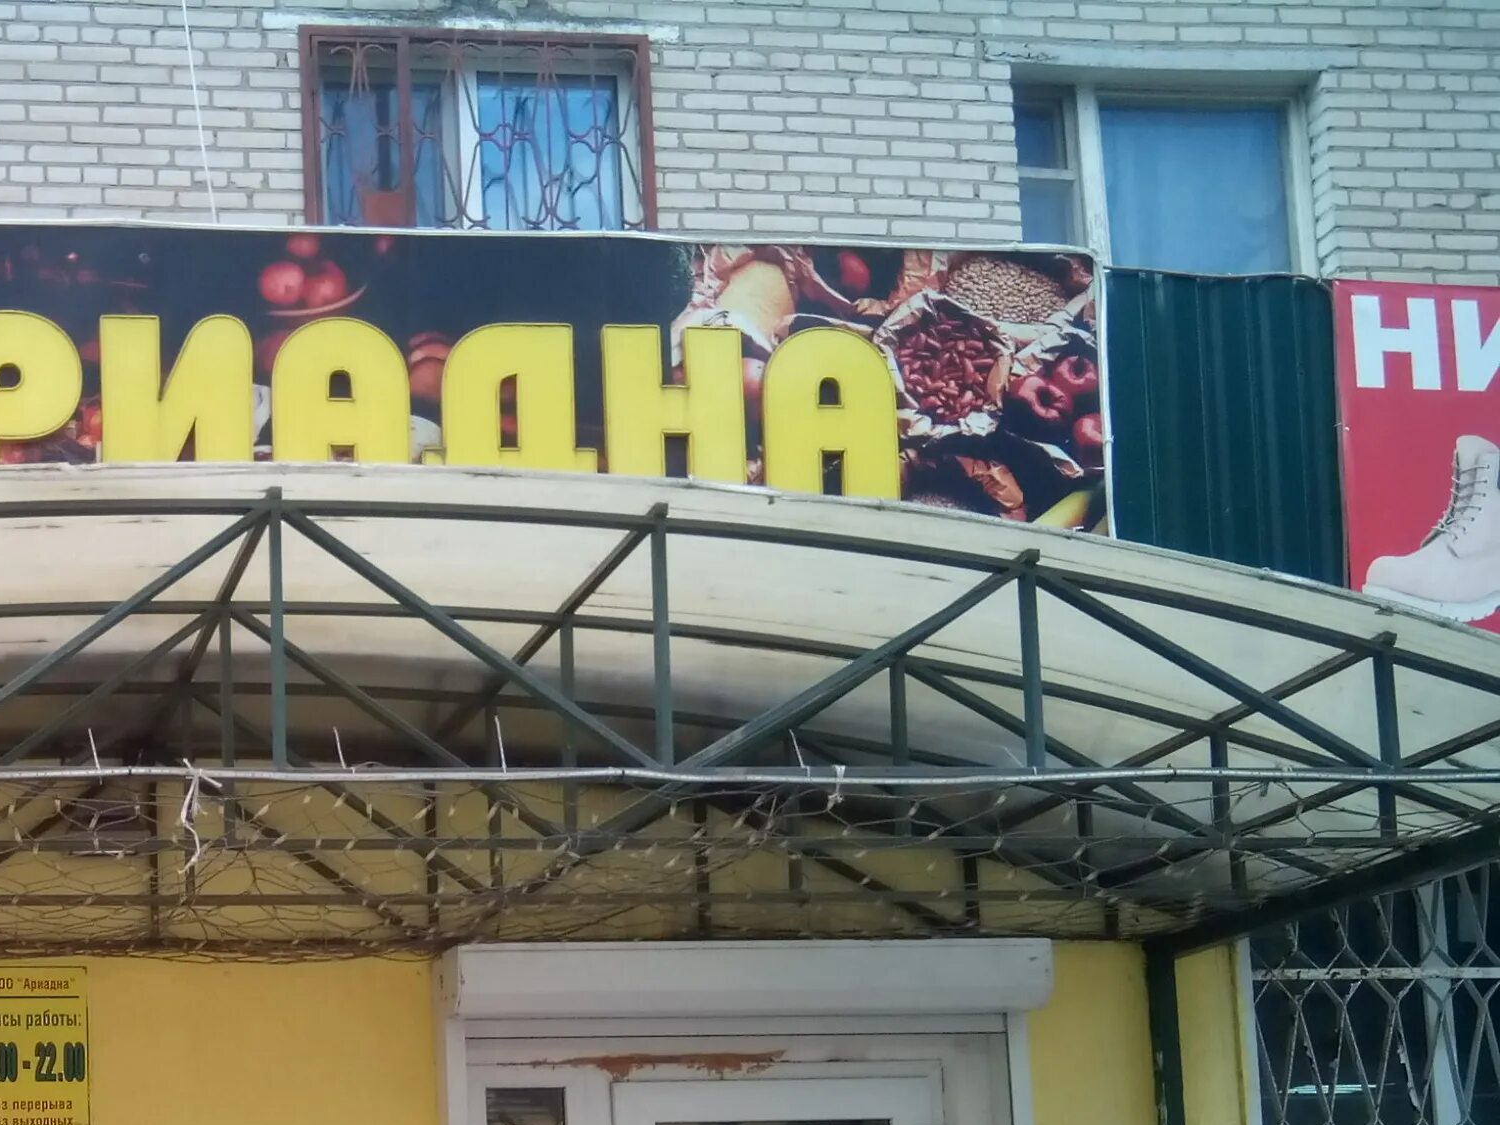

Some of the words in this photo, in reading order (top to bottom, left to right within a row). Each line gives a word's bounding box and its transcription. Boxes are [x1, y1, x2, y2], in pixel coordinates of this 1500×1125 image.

[17, 976, 76, 992] "Ариадна"
[26, 1008, 82, 1031] работы:
[34, 1041, 86, 1083] 22.00
[12, 1099, 73, 1113] перерыва
